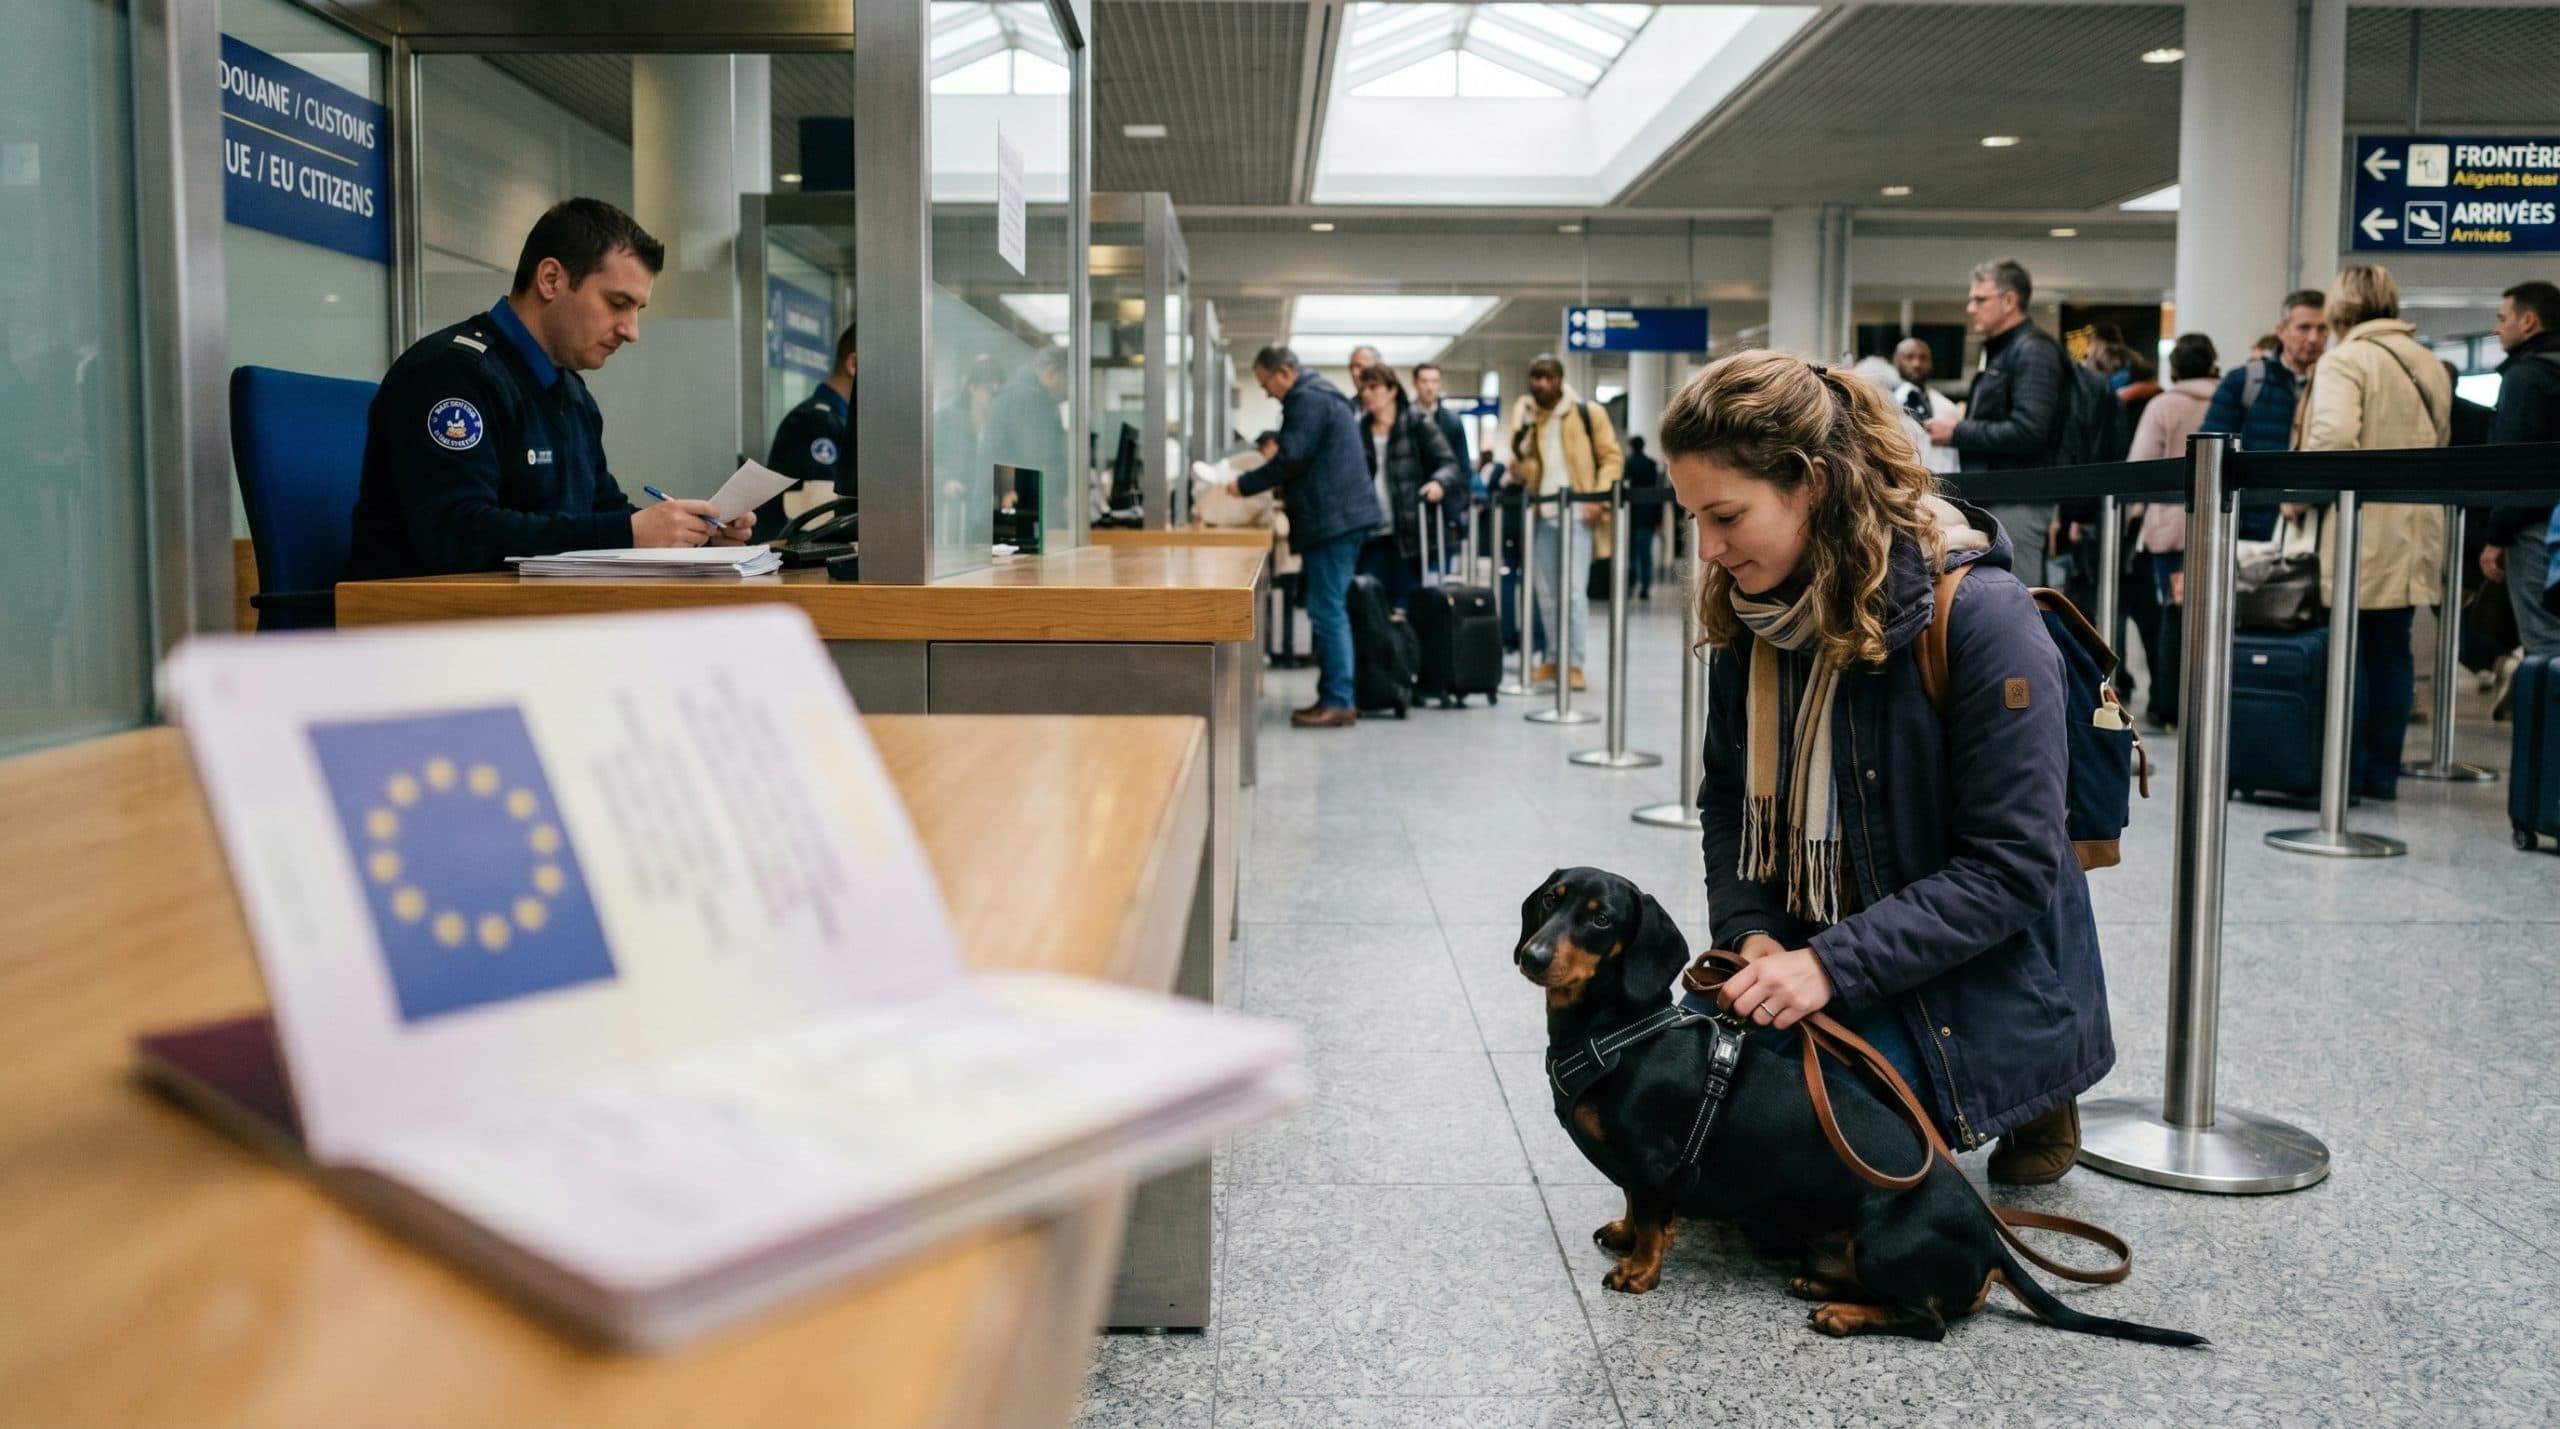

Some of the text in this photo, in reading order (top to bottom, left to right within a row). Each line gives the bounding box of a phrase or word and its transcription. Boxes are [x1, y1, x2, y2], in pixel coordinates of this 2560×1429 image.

[219, 60, 291, 115] DOUANE
[294, 92, 301, 120] /
[226, 139, 374, 218] UE / EU CITIZENS
[2451, 199, 2556, 224] ARRIVÉES
[2451, 228, 2512, 242] Arrivées
